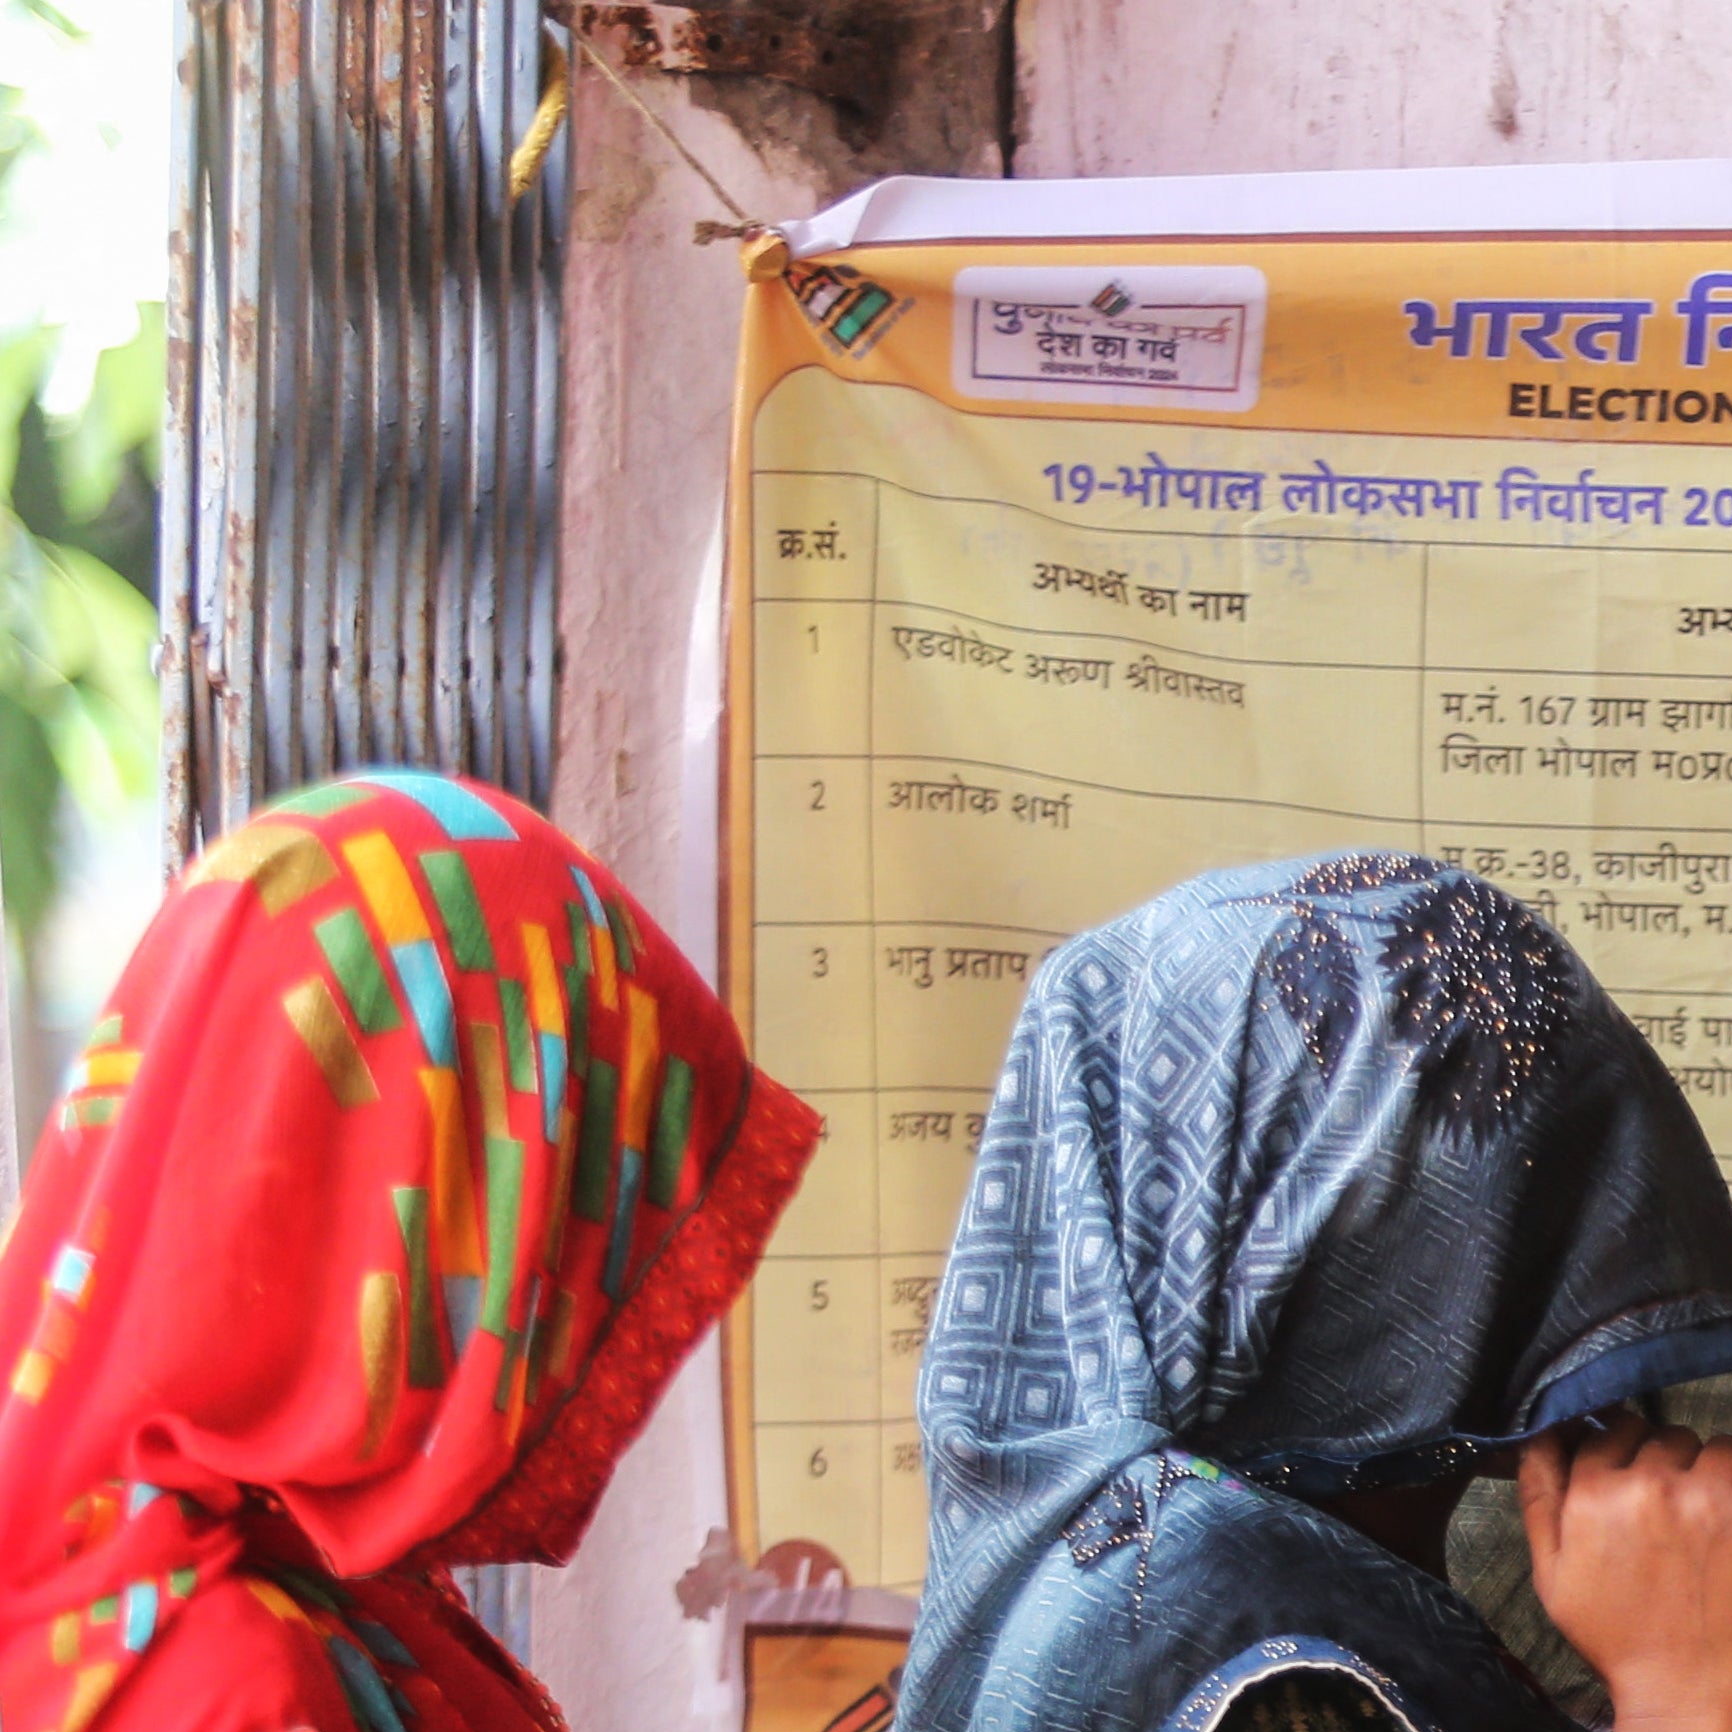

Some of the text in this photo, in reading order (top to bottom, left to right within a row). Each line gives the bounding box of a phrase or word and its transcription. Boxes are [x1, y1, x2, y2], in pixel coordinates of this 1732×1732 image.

[1036, 322, 1083, 358] देश
[1091, 333, 1127, 360] का
[1409, 300, 1652, 363] भारत
[1042, 450, 1266, 514] 19-भोपाल
[1280, 459, 1480, 520] लोकसभा
[1497, 465, 1670, 525] निर्वाचन
[777, 521, 847, 561] क्र.सं.
[1136, 583, 1178, 618] का
[1189, 588, 1249, 623] नाम
[807, 624, 820, 654] 1
[892, 624, 1013, 673] एडवोकेट
[1124, 654, 1246, 708] श्रीवास्तव
[1521, 697, 1574, 727] 167
[1589, 698, 1647, 729] ग्राम
[1441, 733, 1524, 777] जिला
[1538, 736, 1638, 778] भोपाल
[809, 780, 826, 811] 2
[888, 774, 1072, 829] आलोक शर्मा
[1580, 892, 1689, 938] भोपाल,
[811, 947, 829, 978] 3
[885, 947, 1028, 989] भानु प्रताप
[889, 1112, 955, 1141] अजय
[811, 1280, 829, 1312] 5
[809, 1448, 828, 1479] 6
